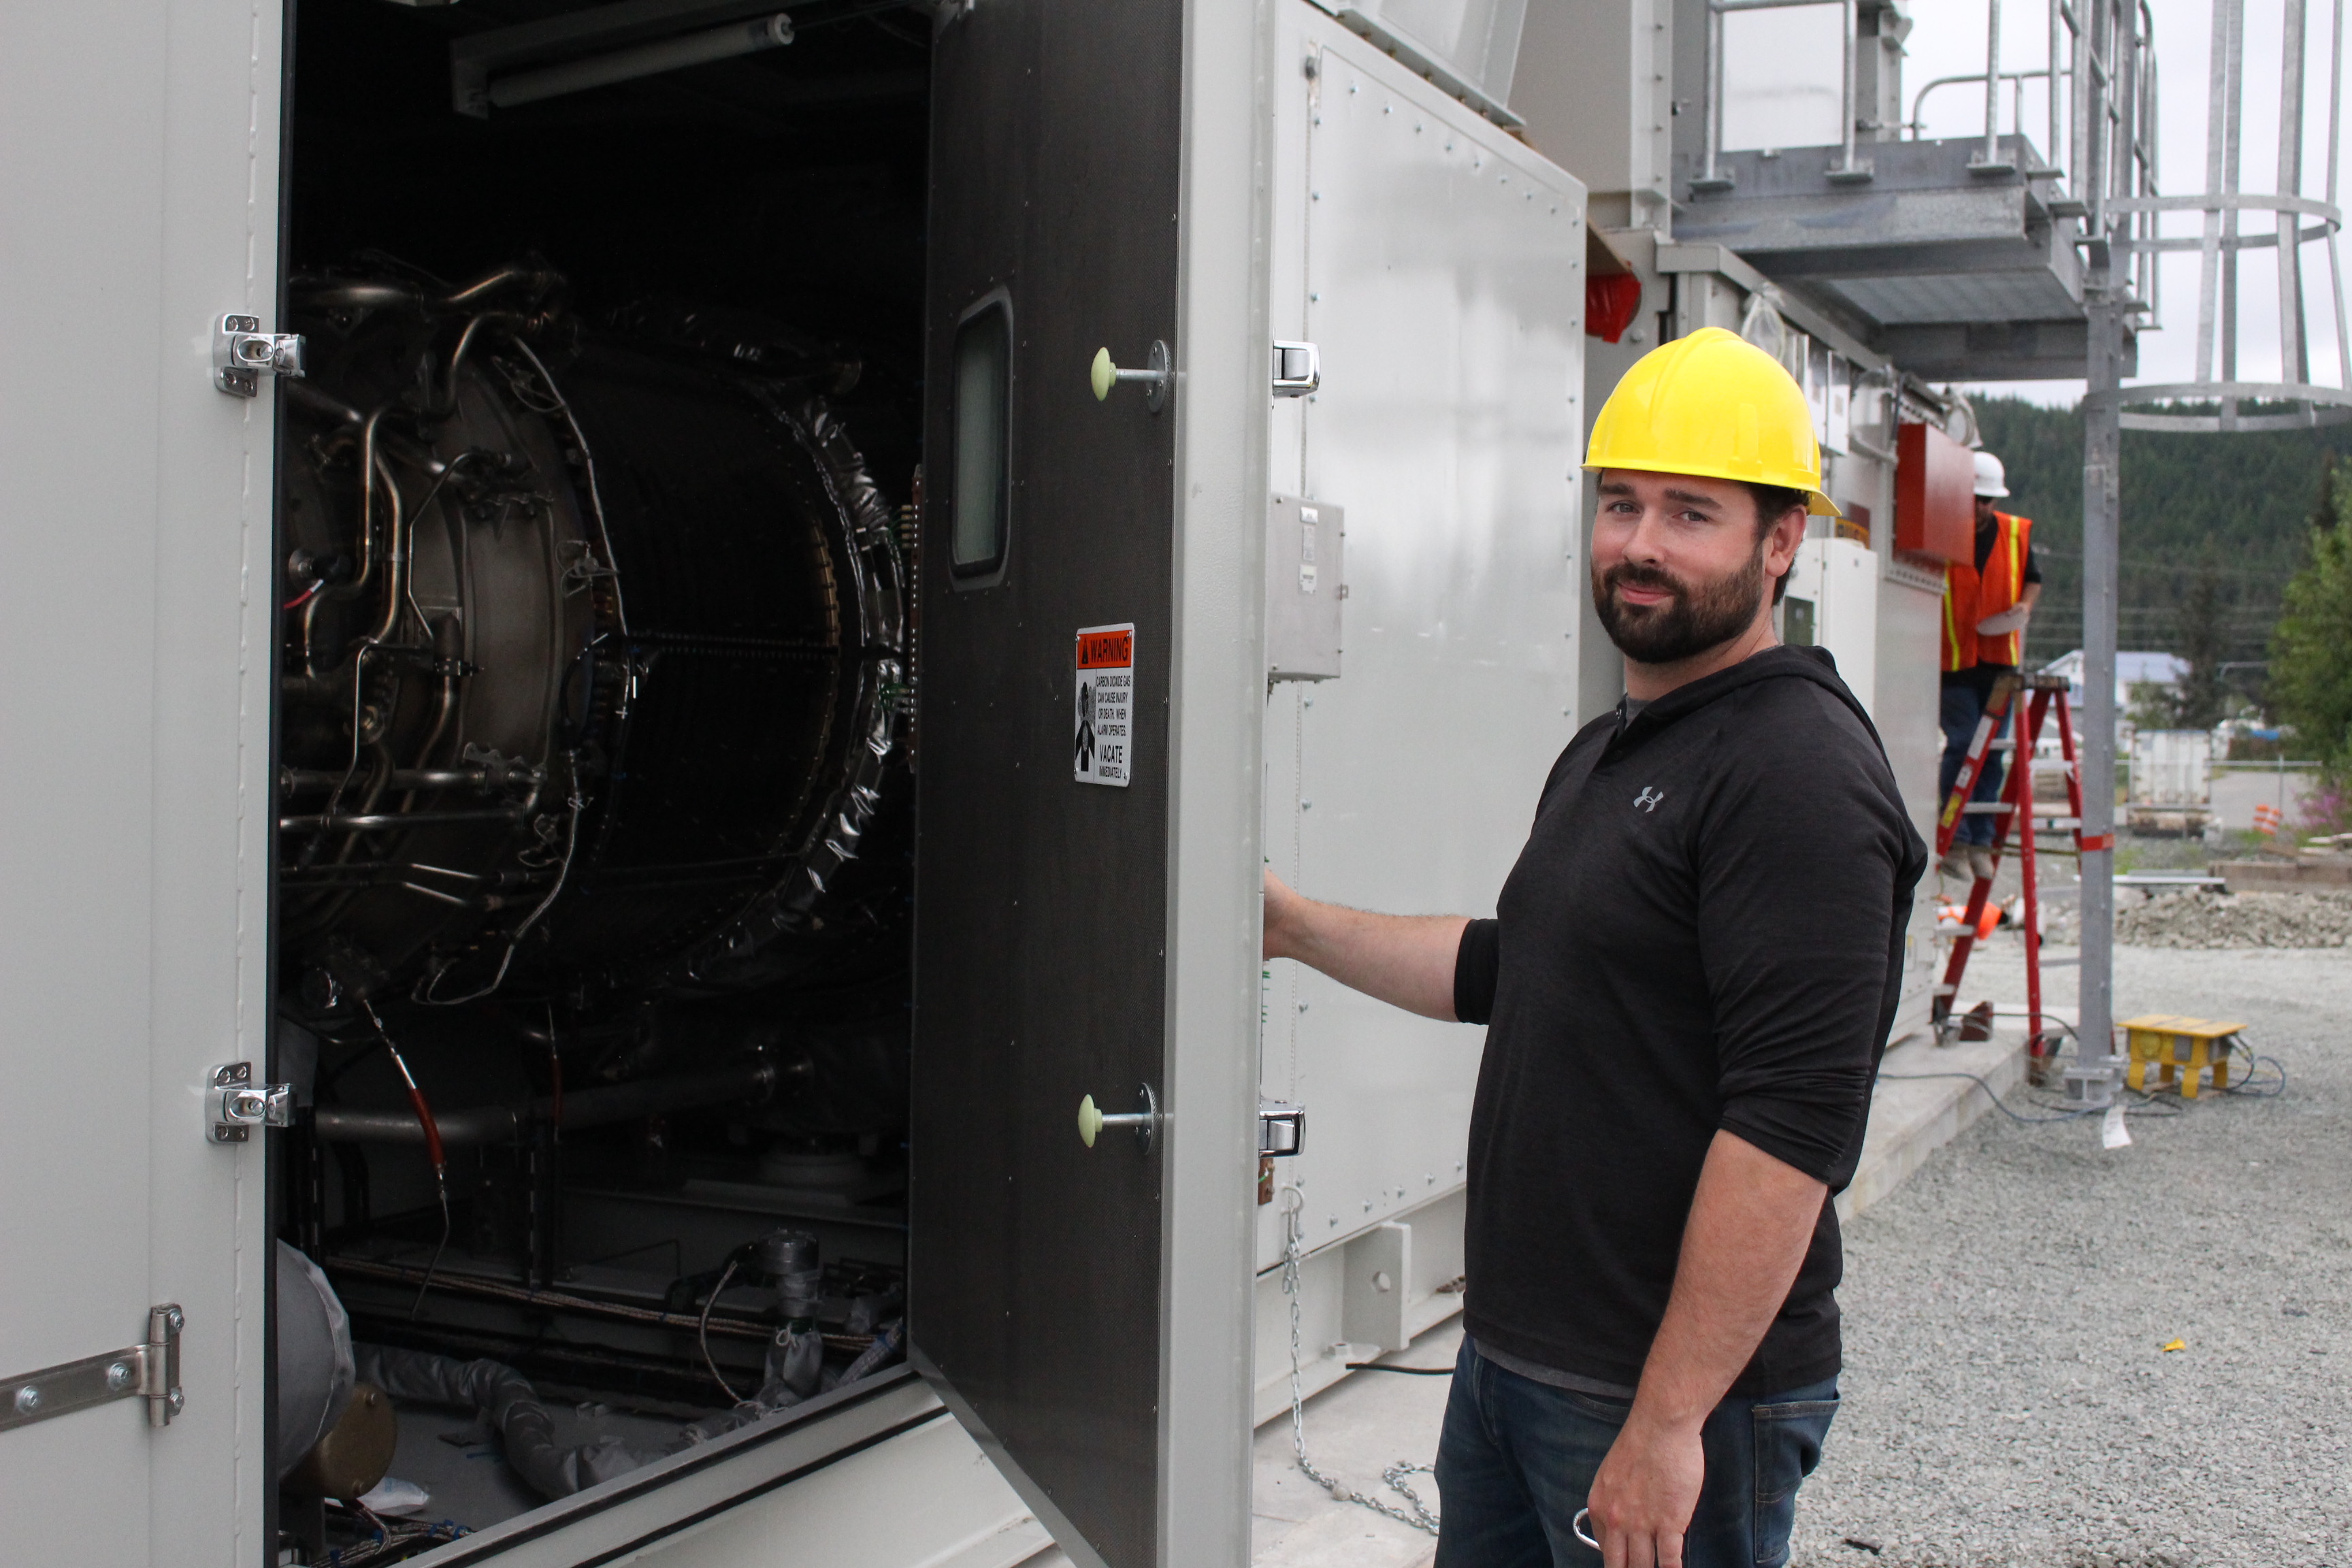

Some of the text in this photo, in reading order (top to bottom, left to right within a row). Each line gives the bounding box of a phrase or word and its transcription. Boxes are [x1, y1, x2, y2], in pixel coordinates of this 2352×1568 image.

[1090, 637, 1128, 663] WARNING
[1096, 676, 1109, 687] CARBON
[1105, 692, 1115, 703] CAUSE
[1116, 692, 1128, 703] INJURY
[1098, 708, 1103, 719] OR
[1116, 708, 1126, 719] WHEN
[1097, 725, 1108, 736] ALARM
[1100, 745, 1123, 763] VACATE
[1099, 766, 1122, 779] IMMEDIATELY
